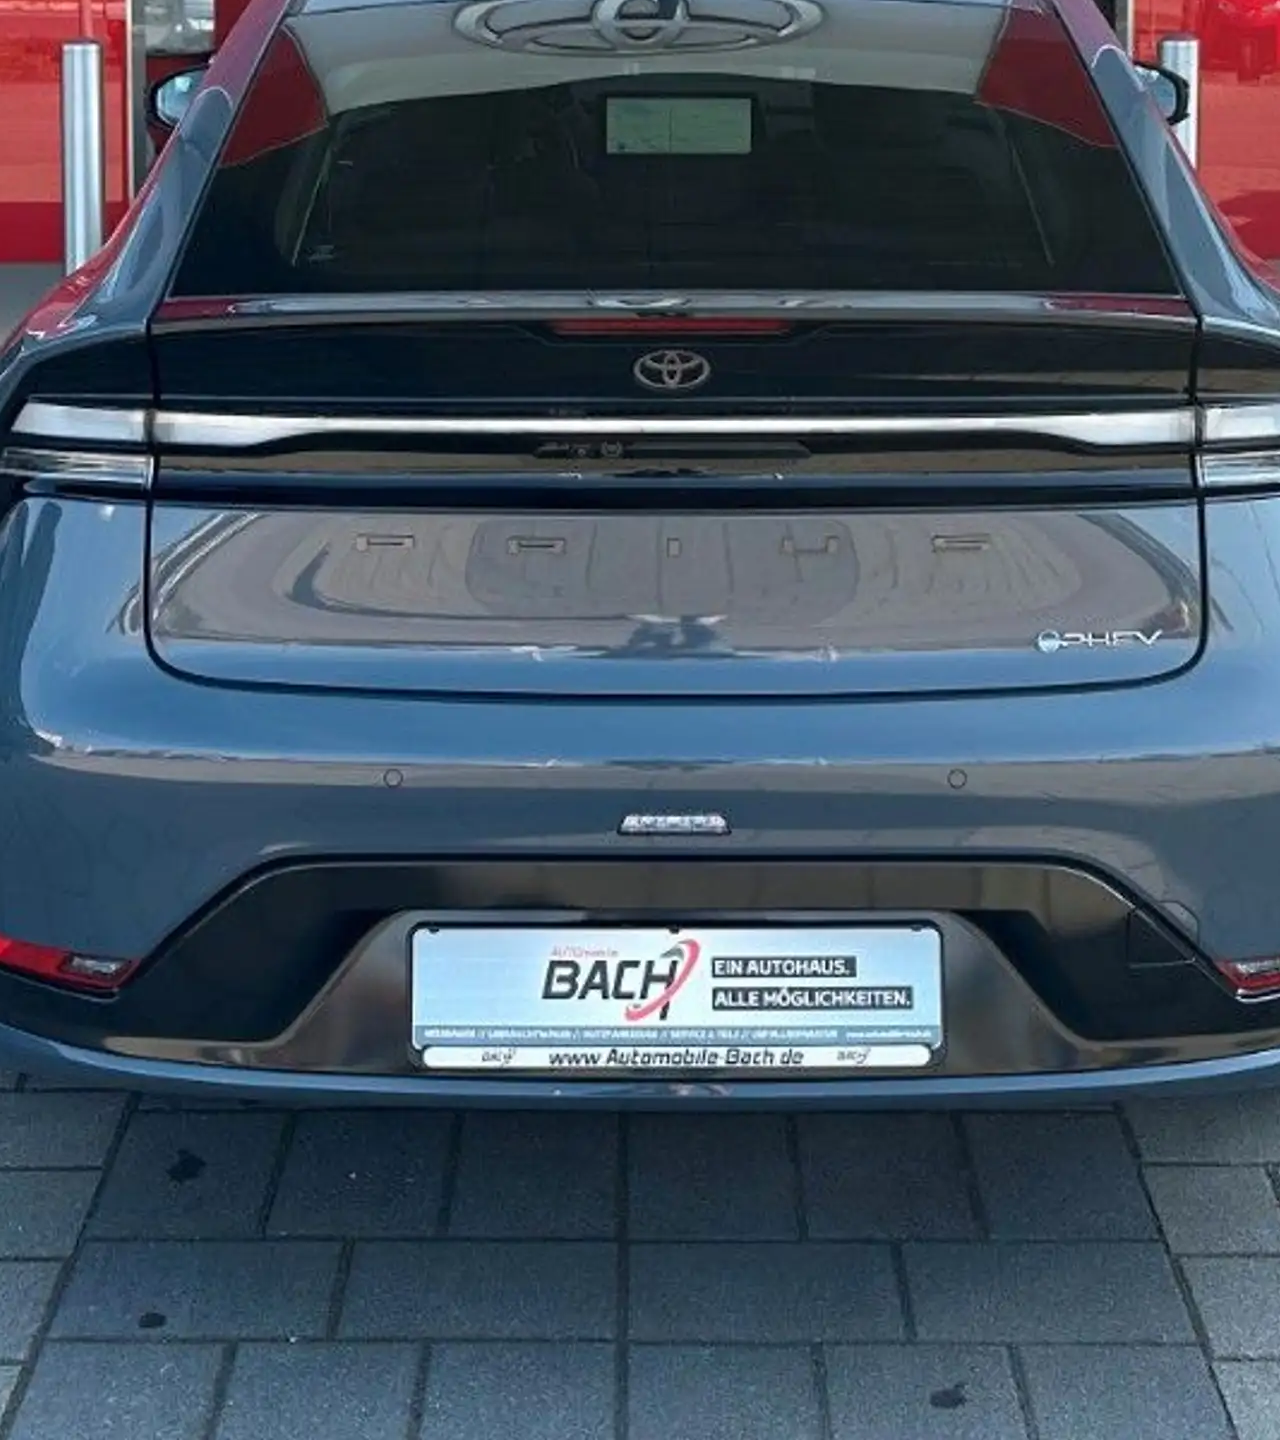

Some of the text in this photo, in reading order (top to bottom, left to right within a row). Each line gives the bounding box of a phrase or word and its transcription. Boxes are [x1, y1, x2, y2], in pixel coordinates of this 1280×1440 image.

[714, 959, 851, 976] EIN AUTOHAUS.
[542, 959, 682, 1020] BACH
[714, 988, 912, 1007] ALLE MÖGLICHKEITEN.
